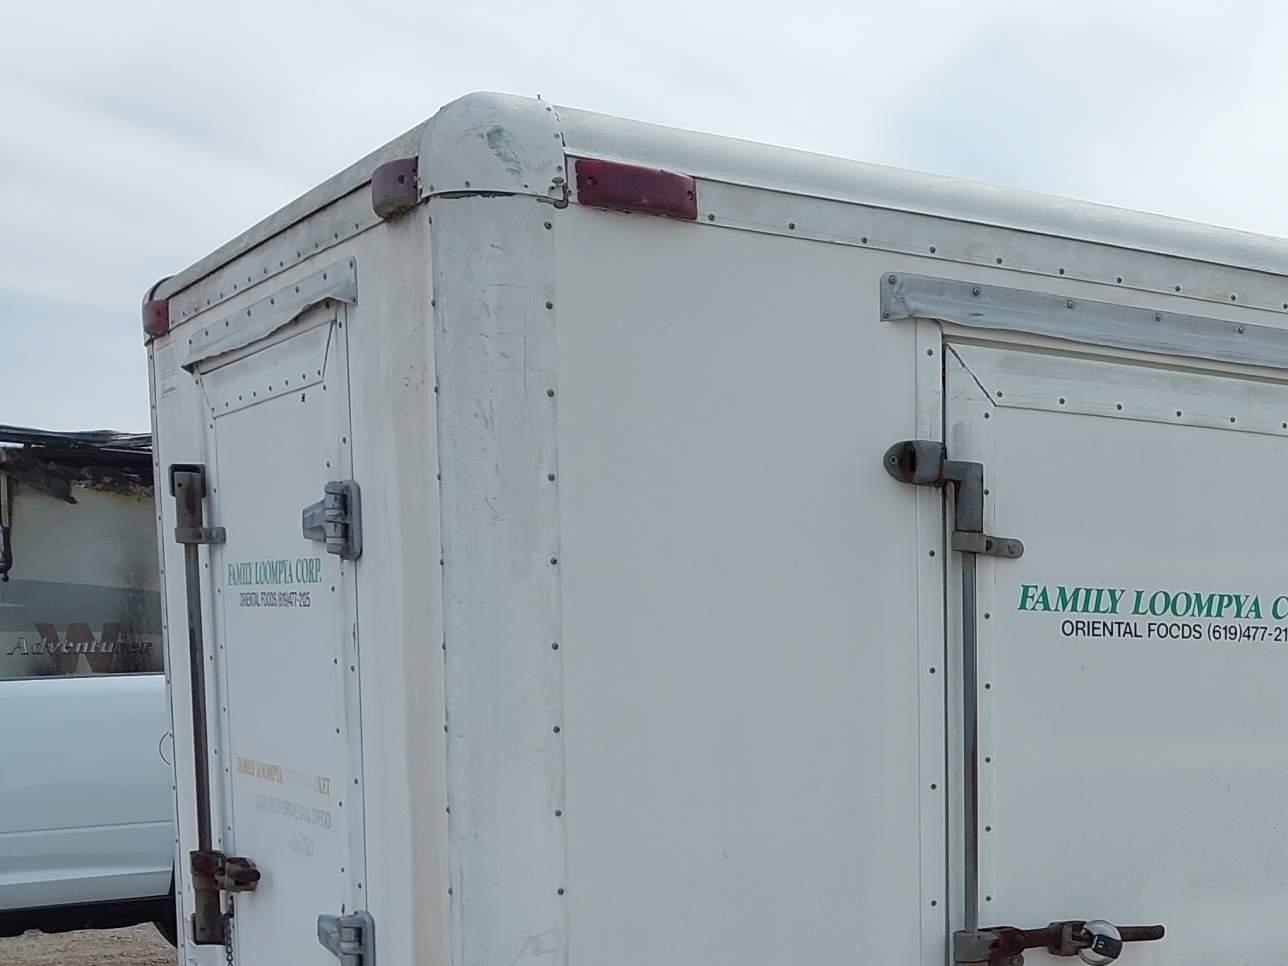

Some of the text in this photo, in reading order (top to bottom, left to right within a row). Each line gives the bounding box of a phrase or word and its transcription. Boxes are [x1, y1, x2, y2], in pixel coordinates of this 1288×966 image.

[227, 562, 253, 586] FAMILY
[295, 557, 322, 584] CORP.
[1016, 583, 1126, 615] FAMILY
[1132, 589, 1263, 621] LOOMPYA
[1060, 619, 1143, 639] ORIENTAL
[1147, 622, 1203, 640] FOODS
[6, 636, 153, 656] Adventurer
